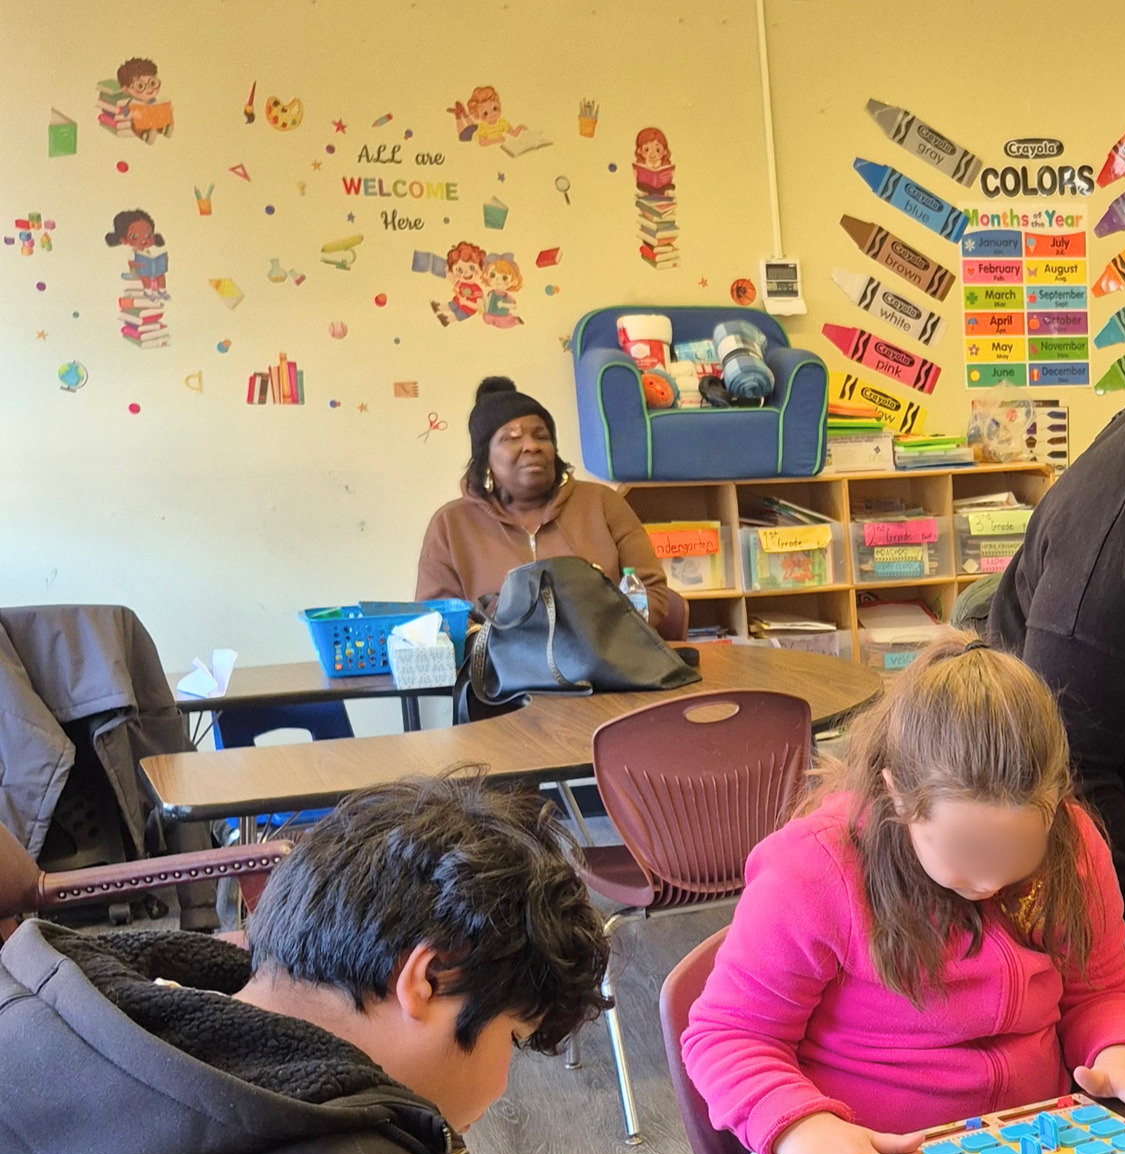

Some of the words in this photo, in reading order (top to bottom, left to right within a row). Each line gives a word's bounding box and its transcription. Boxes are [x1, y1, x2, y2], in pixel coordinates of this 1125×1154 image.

[919, 125, 953, 153] Crayola
[357, 144, 403, 164] ALL
[415, 152, 445, 165] are
[917, 143, 945, 165] gray
[1006, 141, 1058, 159] Crayola
[341, 177, 459, 201] WELCOME
[980, 164, 1095, 198] COLORS
[906, 184, 940, 210] Crayola
[380, 208, 425, 231] Here
[904, 200, 930, 224] blue
[963, 208, 1029, 227] Months
[1044, 209, 1083, 227] Year
[978, 238, 1019, 249] January
[1050, 238, 1070, 250] July
[893, 243, 927, 269] Crayola
[885, 253, 922, 285] brown
[978, 263, 1021, 276] February
[1044, 264, 1078, 276] August
[985, 290, 1016, 300] March
[1039, 289, 1085, 301] September
[885, 292, 918, 318] Crayola
[880, 307, 911, 332] white
[990, 315, 1013, 329] April
[876, 343, 911, 366] Crayola
[991, 342, 1013, 353] May
[1040, 341, 1086, 351] November
[875, 360, 902, 378] pink
[991, 368, 1015, 377] June
[1042, 366, 1086, 376] December
[863, 388, 897, 410] Crayola
[991, 520, 1014, 531] Grade
[777, 540, 803, 548] Grade
[886, 530, 913, 542] Grade
